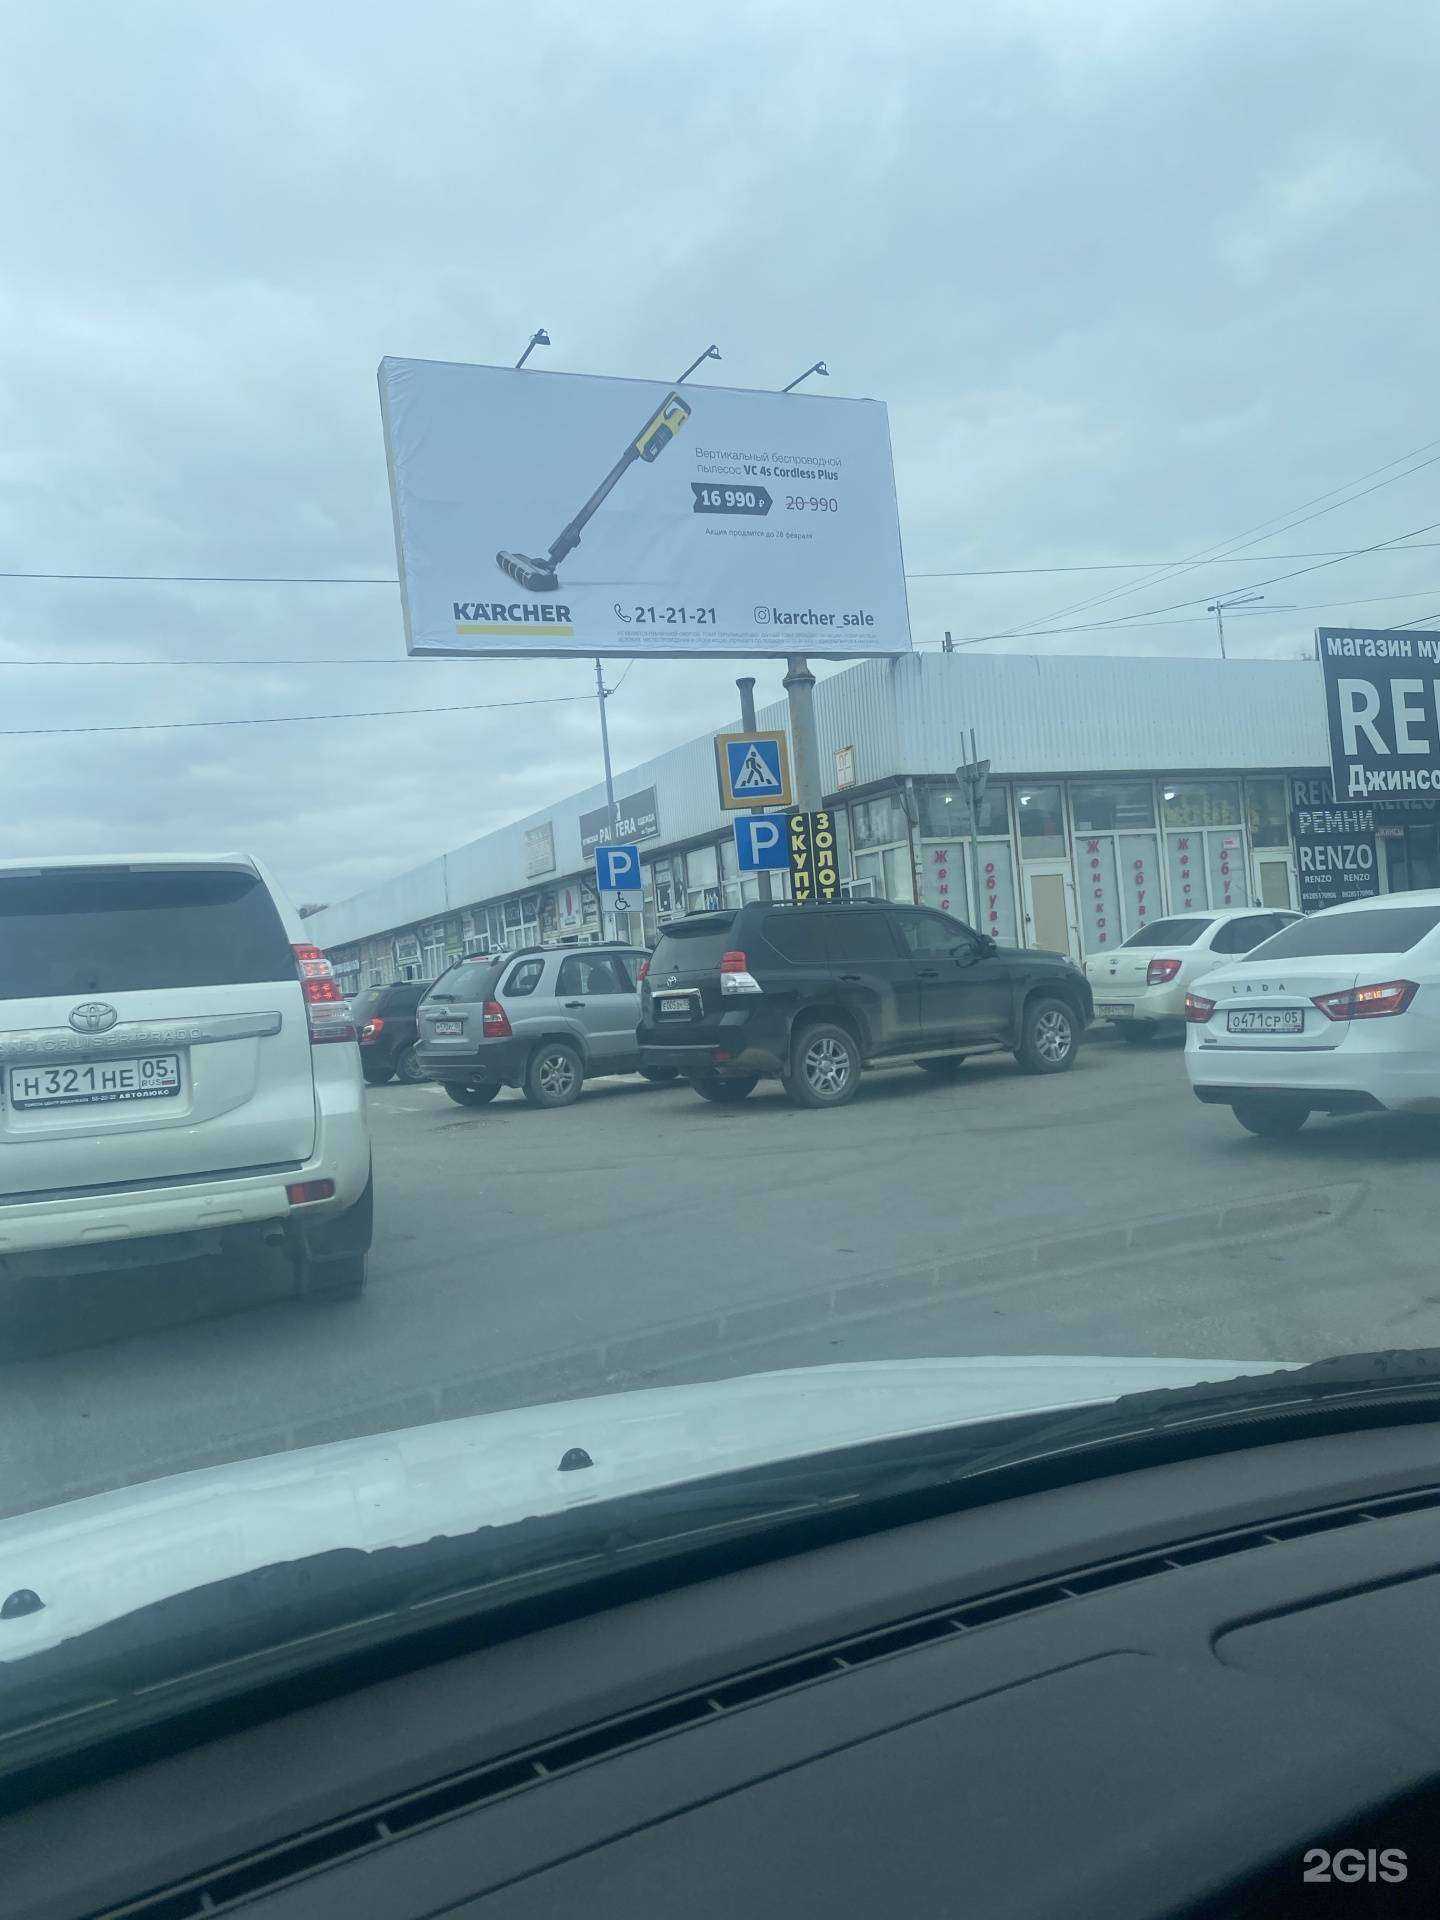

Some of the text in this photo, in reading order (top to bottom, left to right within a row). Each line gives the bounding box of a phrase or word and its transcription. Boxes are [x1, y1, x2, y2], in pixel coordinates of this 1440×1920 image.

[695, 447, 842, 468] Вертикальный беспроводной
[697, 464, 839, 481] пылесос VC 4s Cordless Plus
[701, 489, 721, 506] 16
[724, 491, 756, 508] 990
[786, 495, 838, 512] 20 990
[705, 527, 727, 536] Акция
[453, 602, 572, 622] KÄRCHER
[635, 606, 717, 624] 21-21-21
[773, 608, 874, 628] karcher_sale
[1326, 637, 1412, 657] магазин
[1337, 678, 1440, 756] RE
[599, 817, 637, 843] PATERA
[1299, 810, 1376, 834] РЕМНИ
[750, 822, 779, 865] P
[1300, 844, 1373, 871] RENZO
[1304, 873, 1370, 884] RENZO RENZO
[984, 862, 1000, 937] обувь
[1086, 839, 1107, 943] Женская
[1232, 984, 1286, 994] LADA
[135, 1028, 202, 1042] PRADO
[142, 1059, 168, 1078] 05
[142, 1078, 162, 1087] RUS
